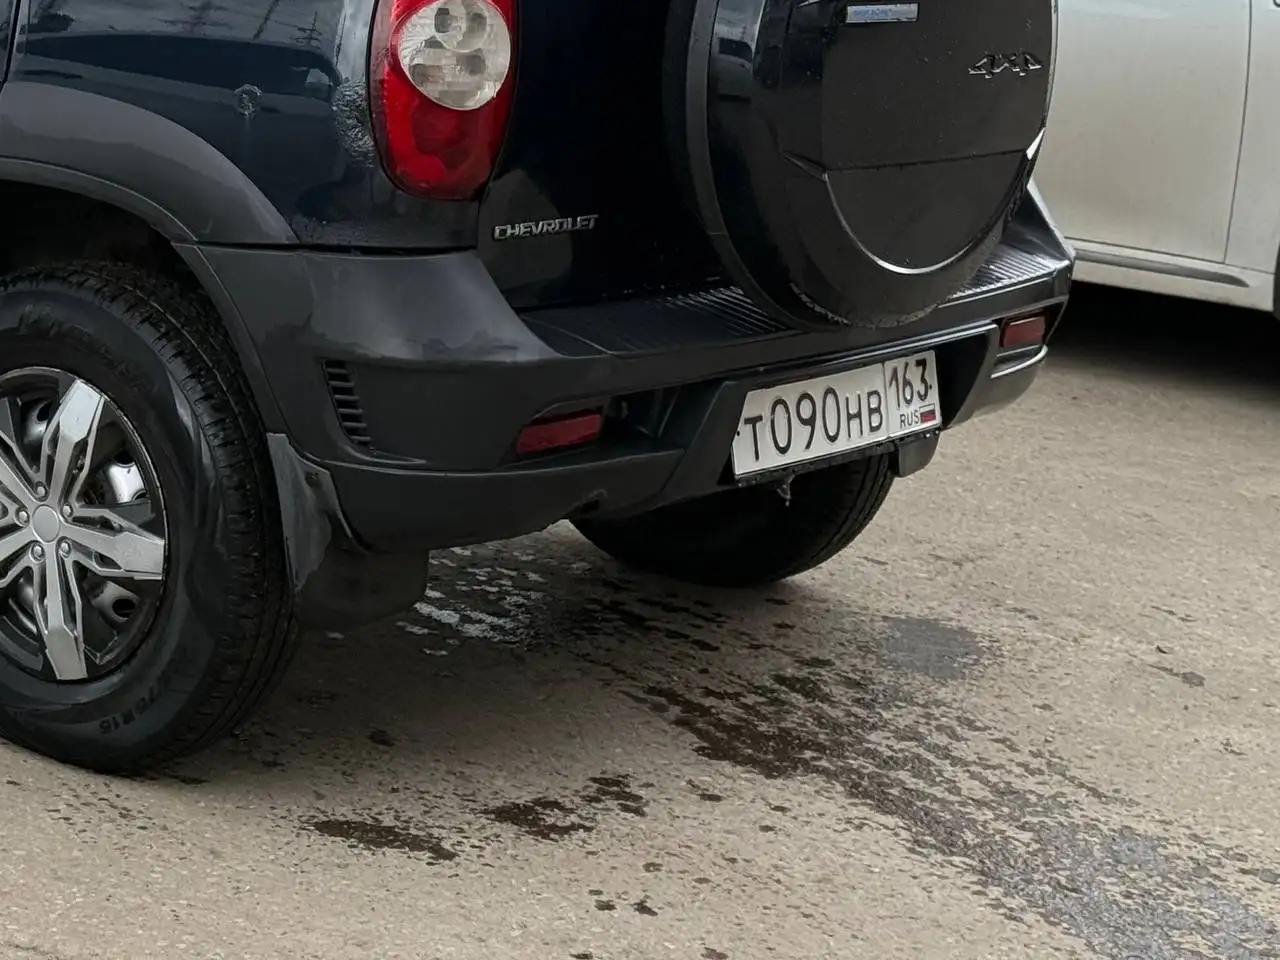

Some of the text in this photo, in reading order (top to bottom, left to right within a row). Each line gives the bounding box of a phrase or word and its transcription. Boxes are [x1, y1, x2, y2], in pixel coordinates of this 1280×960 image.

[494, 214, 599, 240] CHEVROLET
[888, 358, 929, 408] 163
[900, 410, 920, 429] RUS
